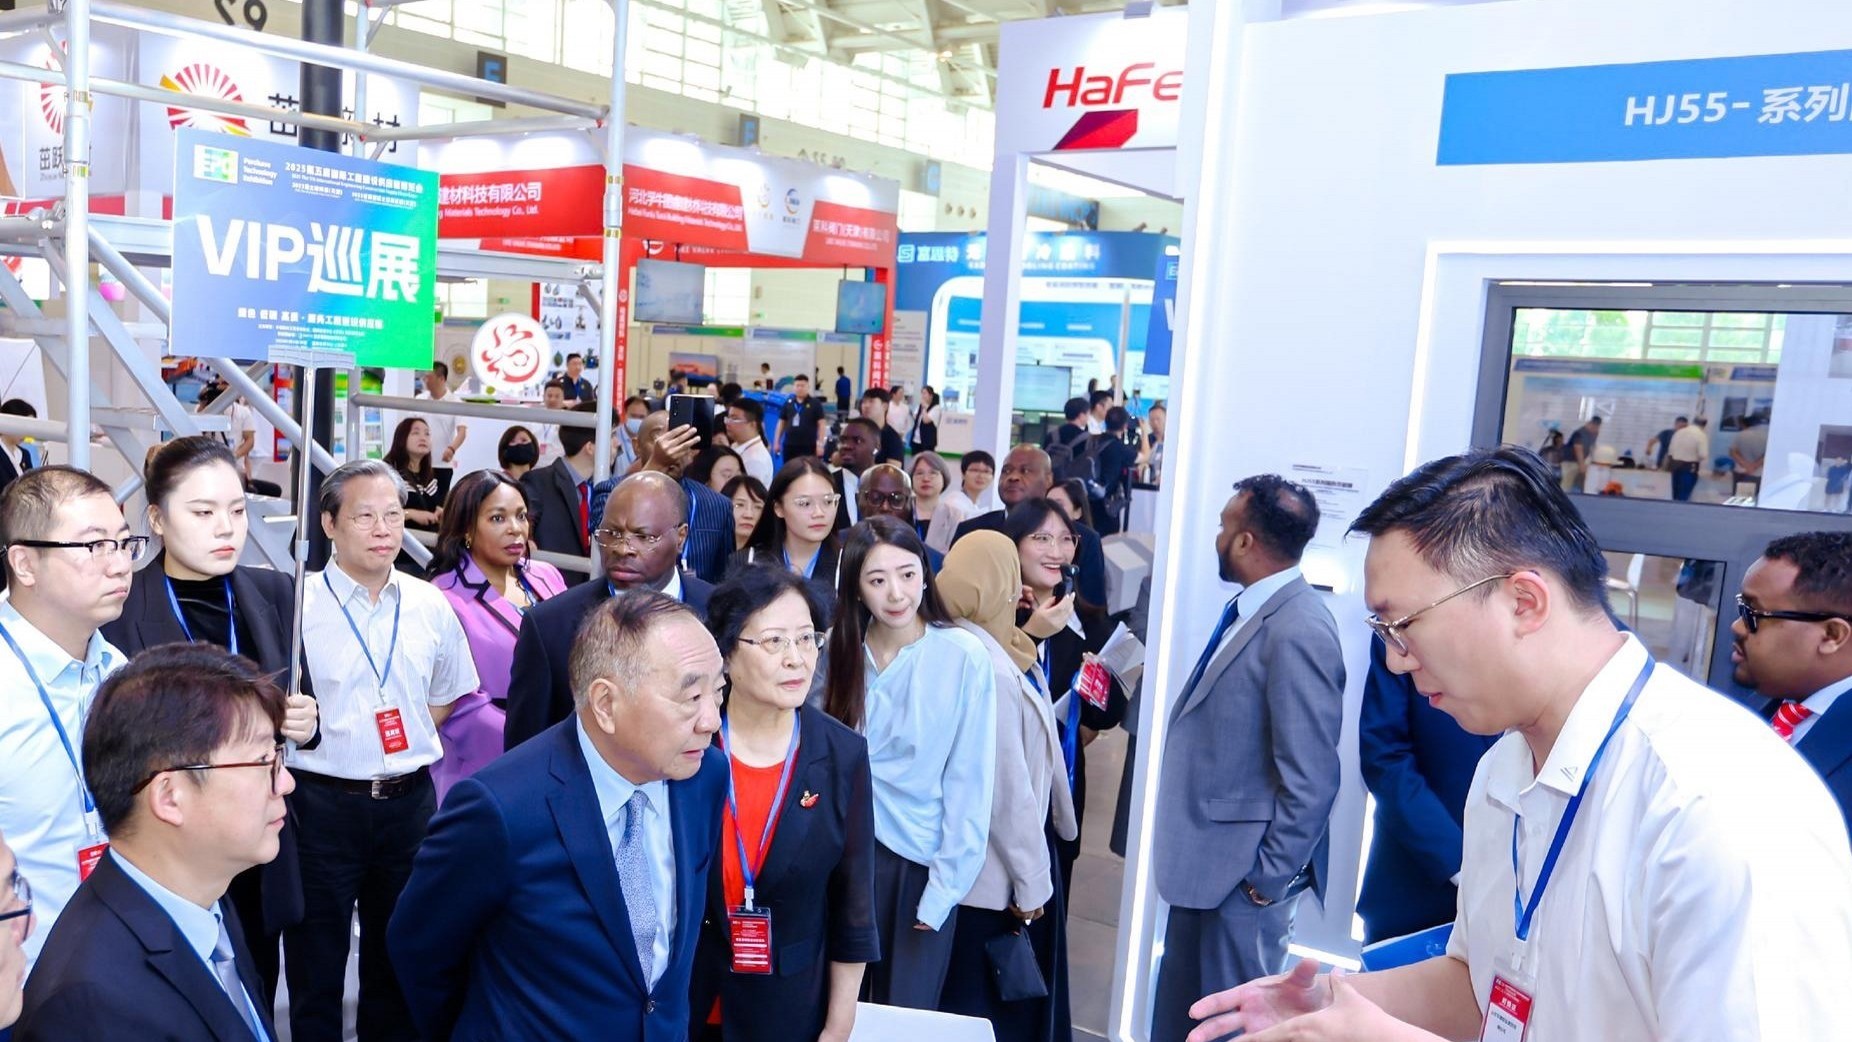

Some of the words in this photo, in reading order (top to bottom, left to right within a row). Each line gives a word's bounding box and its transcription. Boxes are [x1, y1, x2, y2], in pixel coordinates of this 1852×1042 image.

[1758, 82, 1852, 124] 系列
[195, 213, 420, 303] VIP巡展
[917, 245, 959, 262] 富思特
